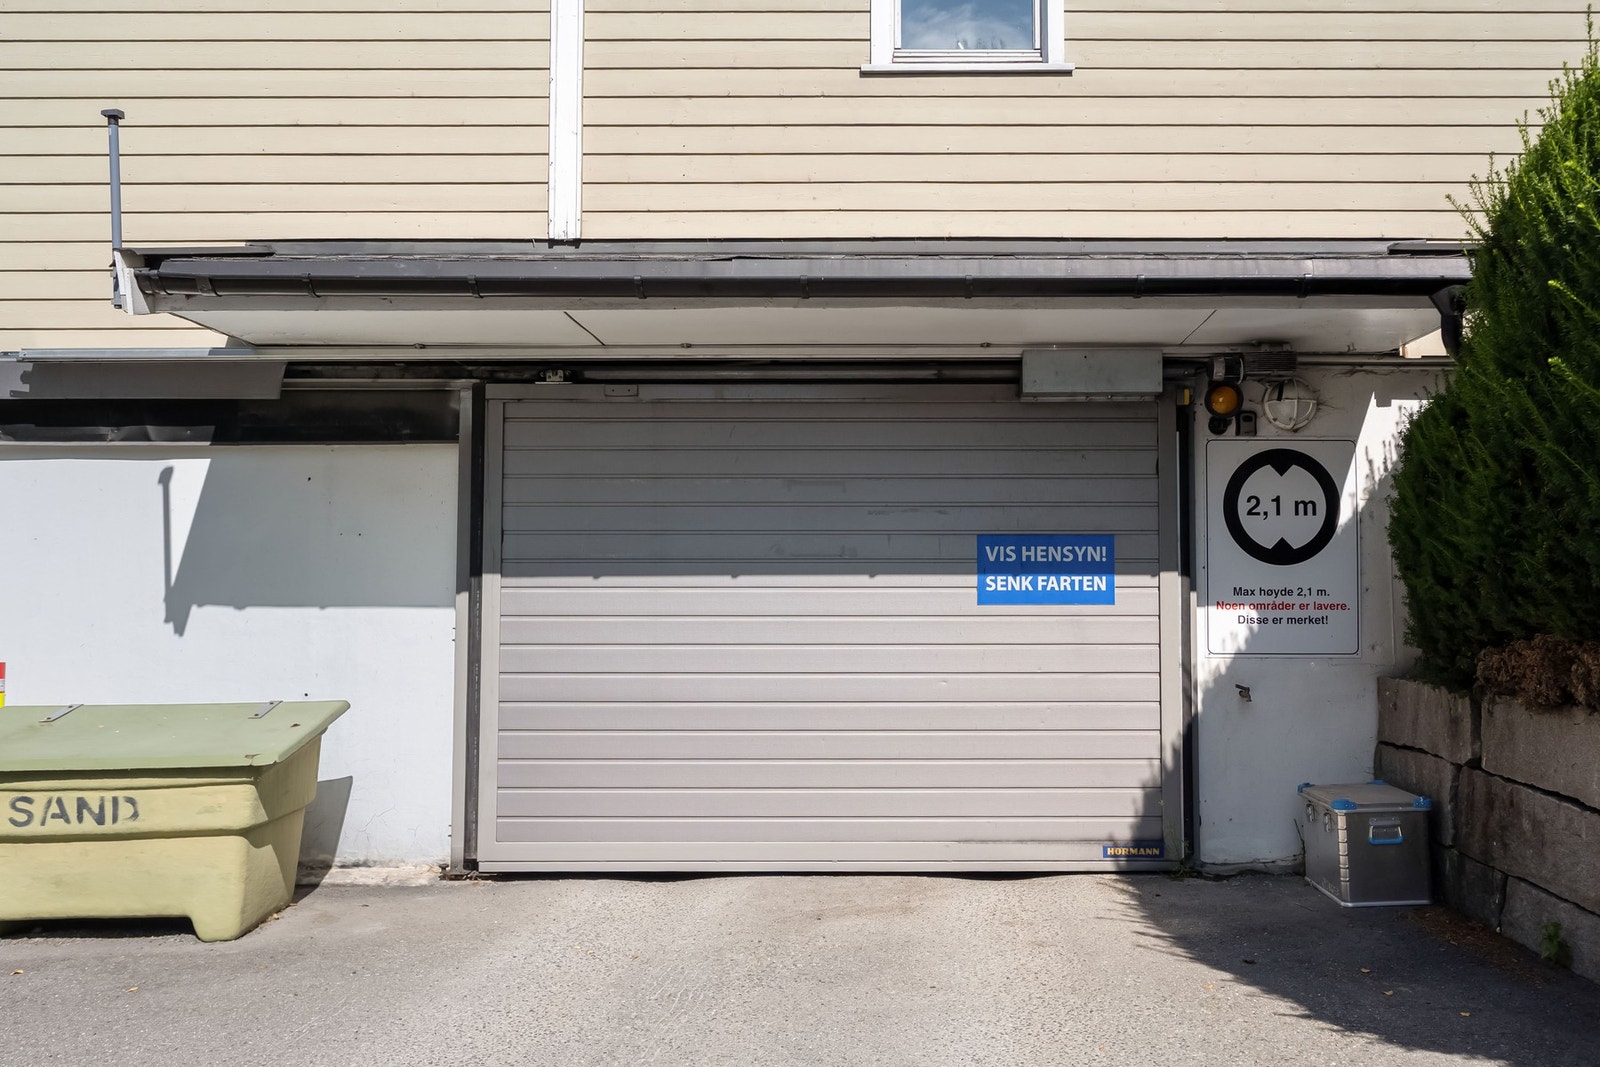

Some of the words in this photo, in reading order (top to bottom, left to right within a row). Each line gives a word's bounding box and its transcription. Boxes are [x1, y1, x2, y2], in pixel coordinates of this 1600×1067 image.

[1246, 495, 1281, 520] 2,1
[1294, 500, 1317, 516] m
[985, 546, 1016, 562] VIS
[1021, 546, 1107, 562] HENSYN!
[985, 576, 1033, 591] SENK
[1037, 576, 1106, 591] FARTEN
[1233, 587, 1256, 596] Max
[1259, 587, 1294, 598] høyde
[1296, 587, 1312, 598] 2,1
[1316, 589, 1330, 597] m.
[1216, 601, 1245, 610] Noen
[1248, 601, 1296, 611] områder
[1298, 602, 1310, 611] er
[1313, 601, 1350, 611] lavere.
[1238, 615, 1269, 624] Disse
[1272, 616, 1283, 625] er
[1286, 615, 1329, 625] merket!
[8, 796, 140, 827] SAND
